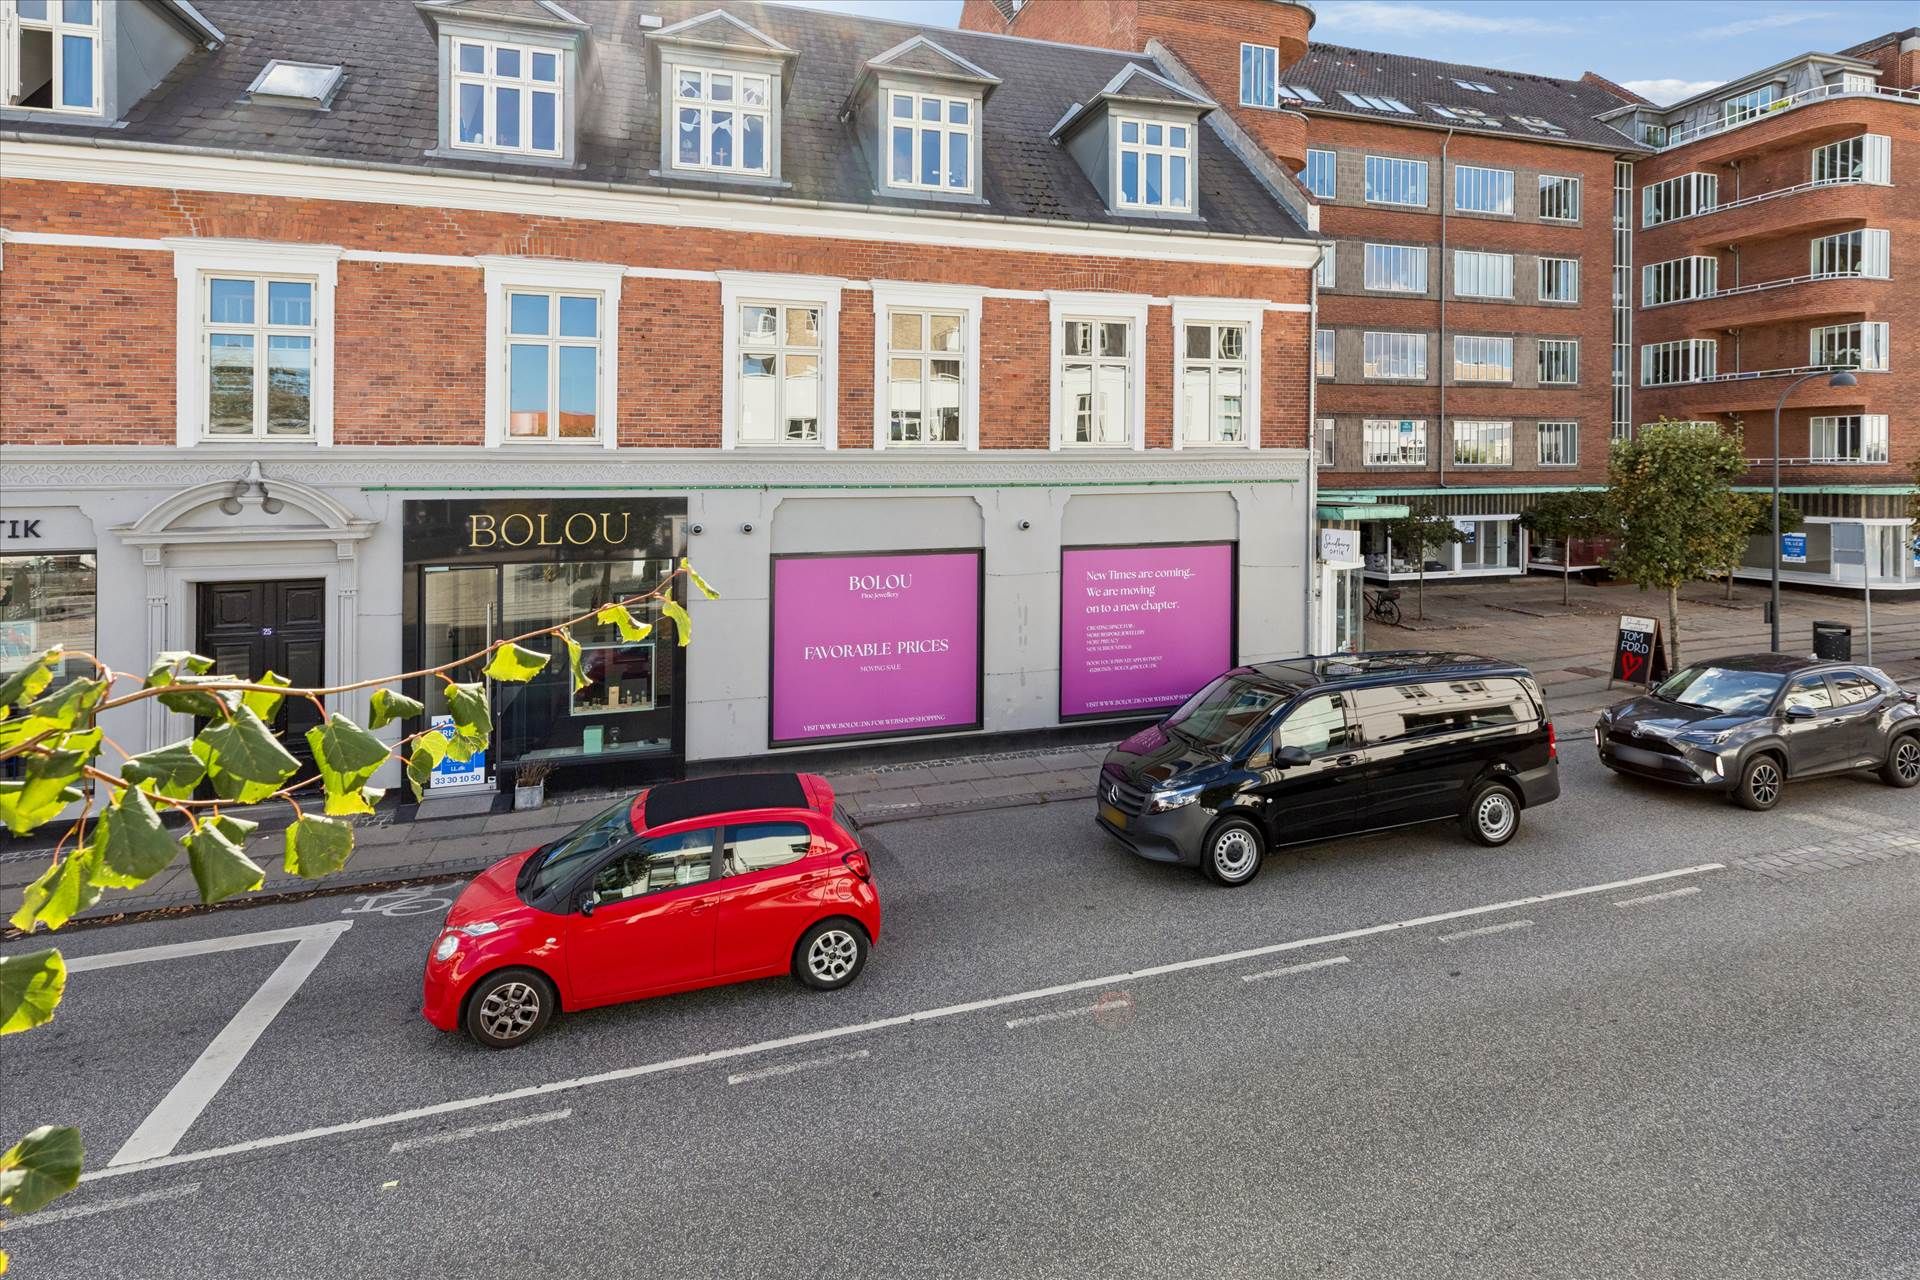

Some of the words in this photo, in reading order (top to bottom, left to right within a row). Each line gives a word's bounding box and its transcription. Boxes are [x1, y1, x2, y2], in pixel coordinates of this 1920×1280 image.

[0, 519, 42, 539] IK
[468, 511, 631, 547] BOLOU
[1086, 571, 1106, 581] New
[1108, 569, 1137, 580] Times
[1138, 570, 1154, 579] are
[848, 573, 912, 591] BOLOU
[1086, 587, 1102, 597] We
[1103, 588, 1119, 597] are
[1120, 585, 1156, 597] moving
[1086, 604, 1099, 614] on
[1100, 603, 1112, 613] to
[1120, 602, 1139, 612] new
[1140, 600, 1180, 612] chapter.
[263, 627, 272, 636] 25
[1621, 630, 1644, 643] TOM
[804, 642, 892, 660] FAVORABLE
[897, 639, 949, 654] PRICES
[1620, 640, 1649, 654] FORD
[860, 665, 886, 673] MOVING
[434, 777, 446, 785] 33
[447, 776, 458, 784] 30
[459, 775, 469, 783] 10
[470, 774, 481, 782] 50
